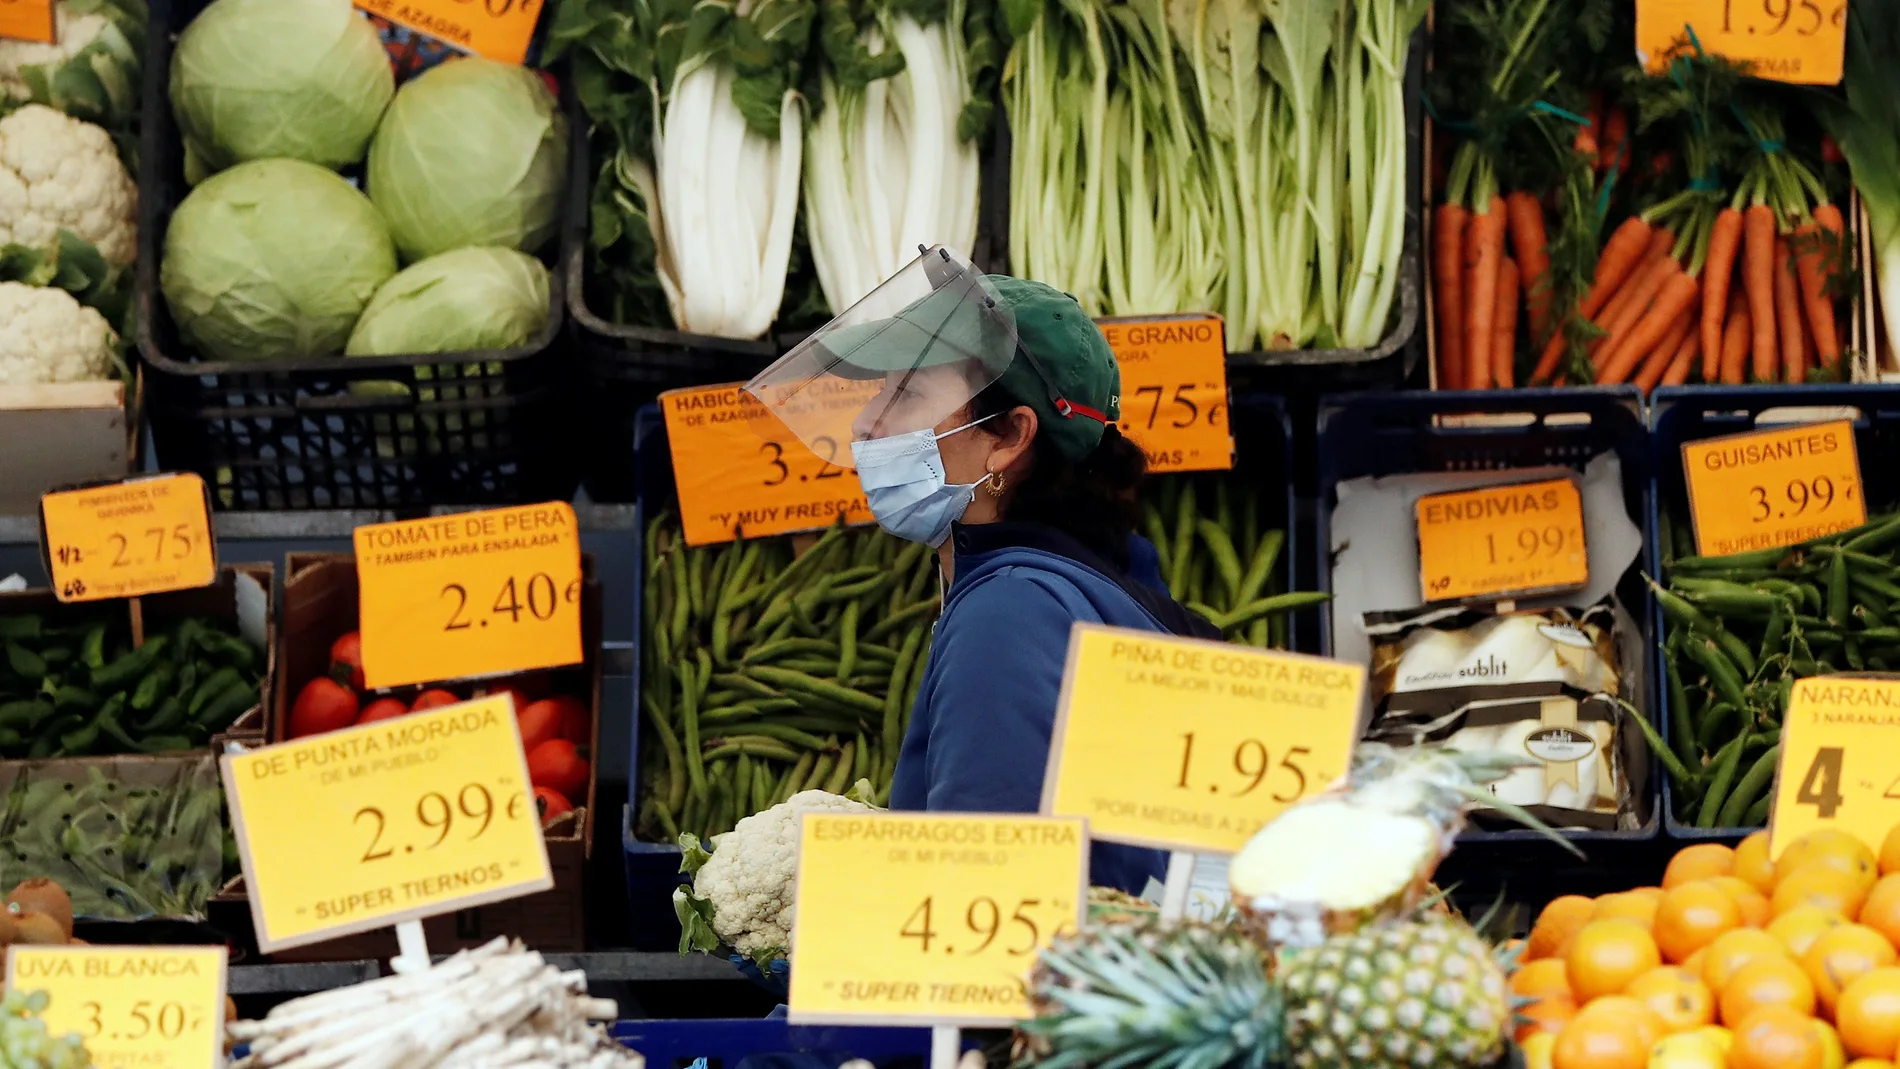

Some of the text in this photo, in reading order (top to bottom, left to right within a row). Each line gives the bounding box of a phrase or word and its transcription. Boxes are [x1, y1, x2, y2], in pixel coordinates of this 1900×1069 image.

[1127, 324, 1213, 346] GRANO
[710, 407, 769, 425] AZAGRA
[760, 434, 859, 487] 3.2
[1705, 431, 1838, 471] GUISANTES
[738, 507, 779, 526] MUY
[1426, 489, 1560, 525] ENDIVIAS
[363, 507, 567, 550] TOMATE DE PERA
[375, 533, 560, 567] TAMBIEN PARA ENSALADA
[1111, 640, 1353, 691] PIÑA DE COSTA RICA
[1459, 654, 1508, 678] sublit
[1152, 672, 1210, 694] MEJOR
[1216, 680, 1225, 695] Y
[1273, 688, 1328, 710] DULCE
[251, 709, 500, 780] DE PUNTA MORADA
[320, 750, 440, 786] DE MI PUEBLO
[1795, 746, 1845, 819] 4
[1142, 804, 1214, 829] MEDIAS
[993, 824, 1076, 847] EXTRA
[888, 849, 1009, 867] DE MI PUEBLO
[314, 862, 505, 921] SUPER TIERNOS
[16, 956, 201, 978] UVA BLANCA
[839, 981, 920, 1002] SUPER
